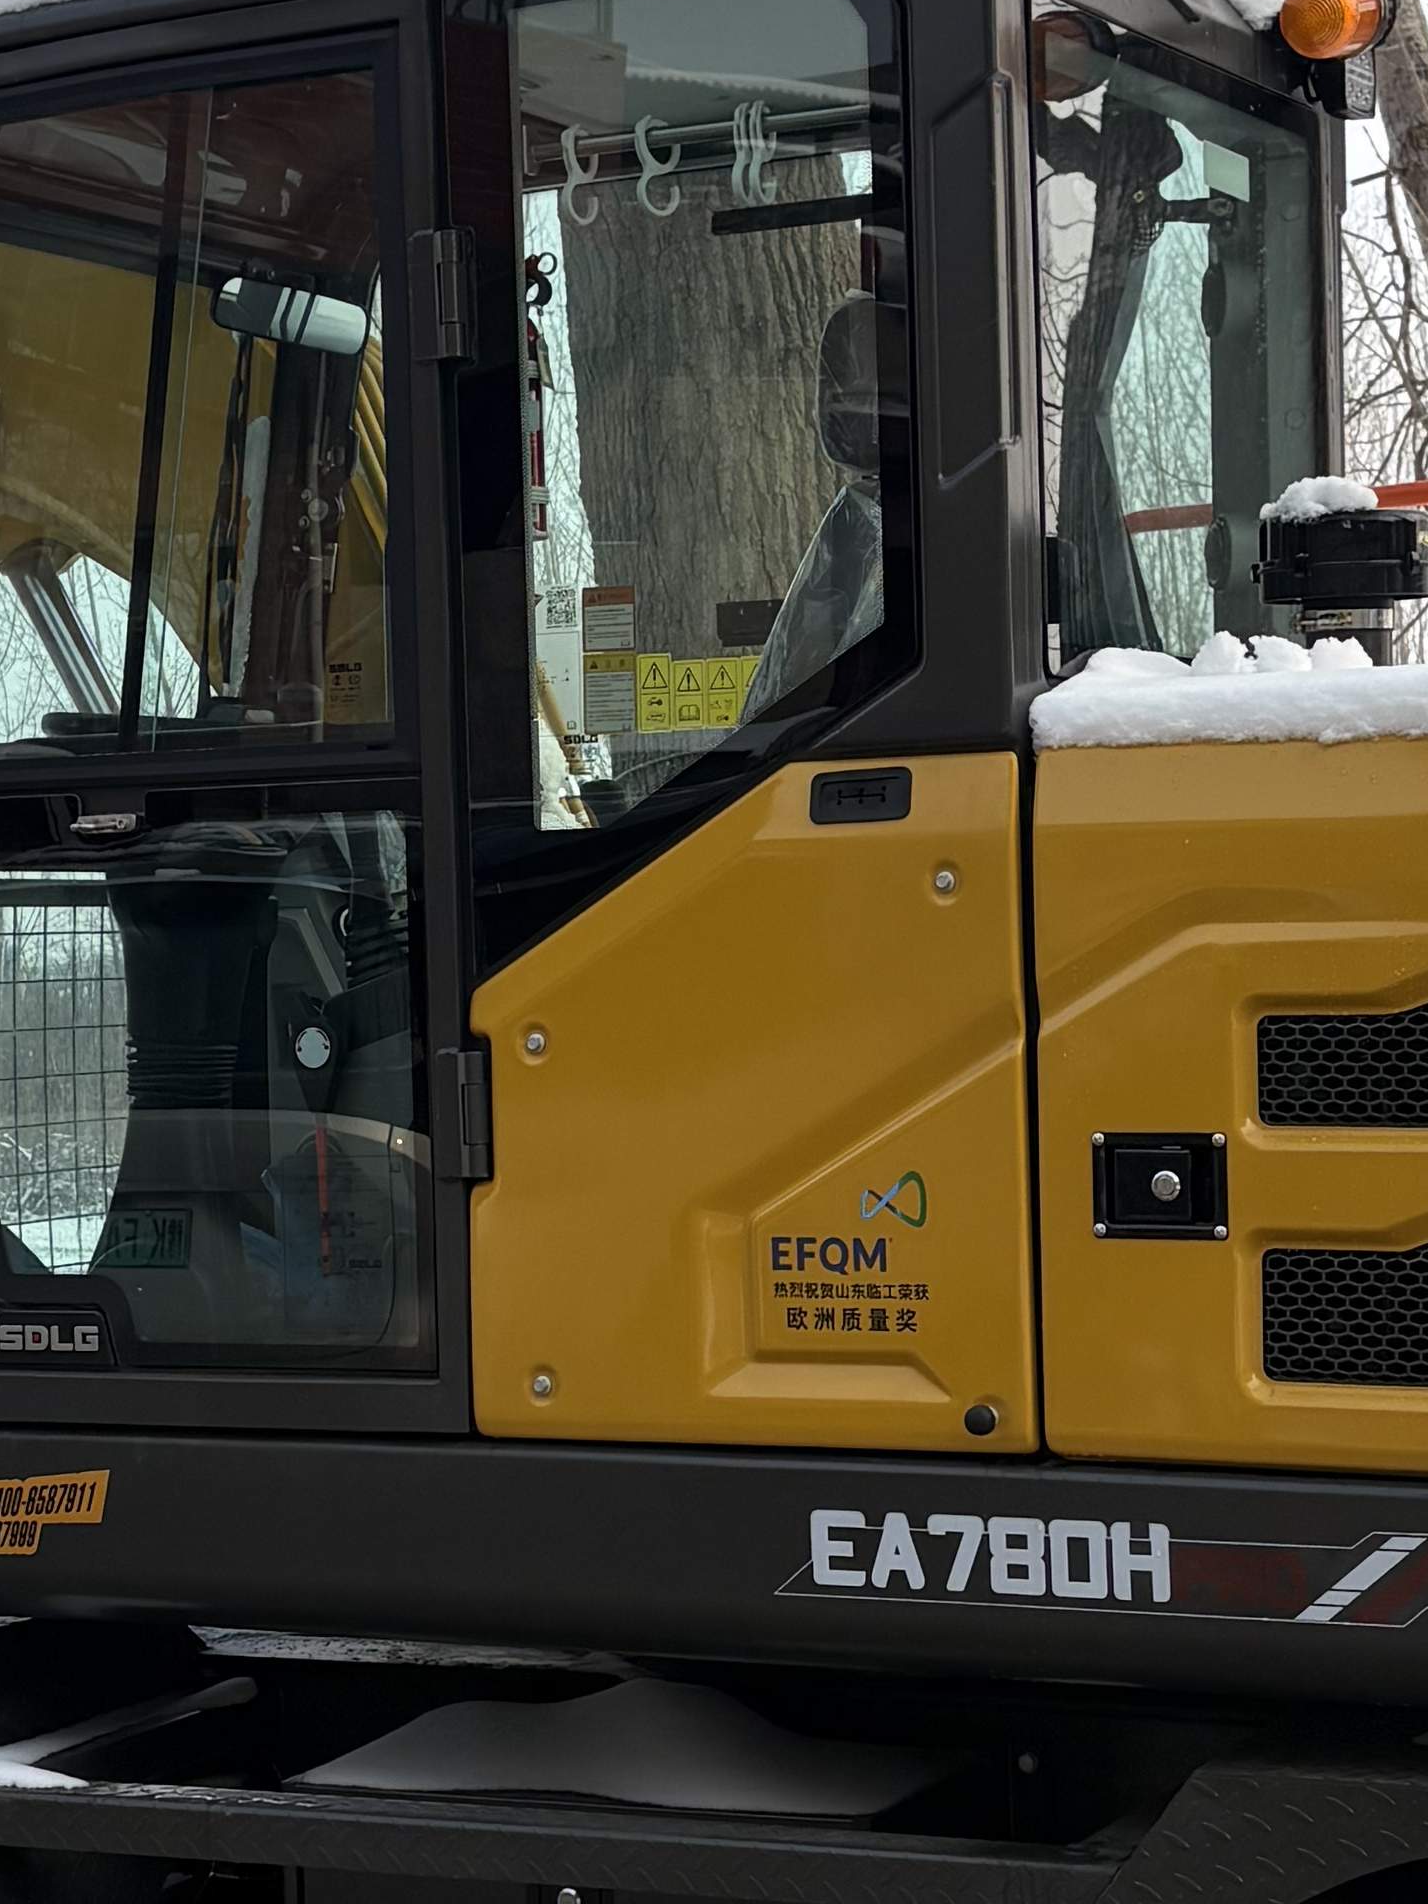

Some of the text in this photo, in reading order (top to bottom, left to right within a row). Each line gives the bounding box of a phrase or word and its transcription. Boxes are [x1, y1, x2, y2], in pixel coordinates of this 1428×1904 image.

[771, 1236, 888, 1275] EFQM
[773, 1282, 930, 1301] 热烈祝贺山东临工荣获
[786, 1307, 918, 1333] 欧洲质量奖
[809, 1508, 1171, 1604] EA780H
